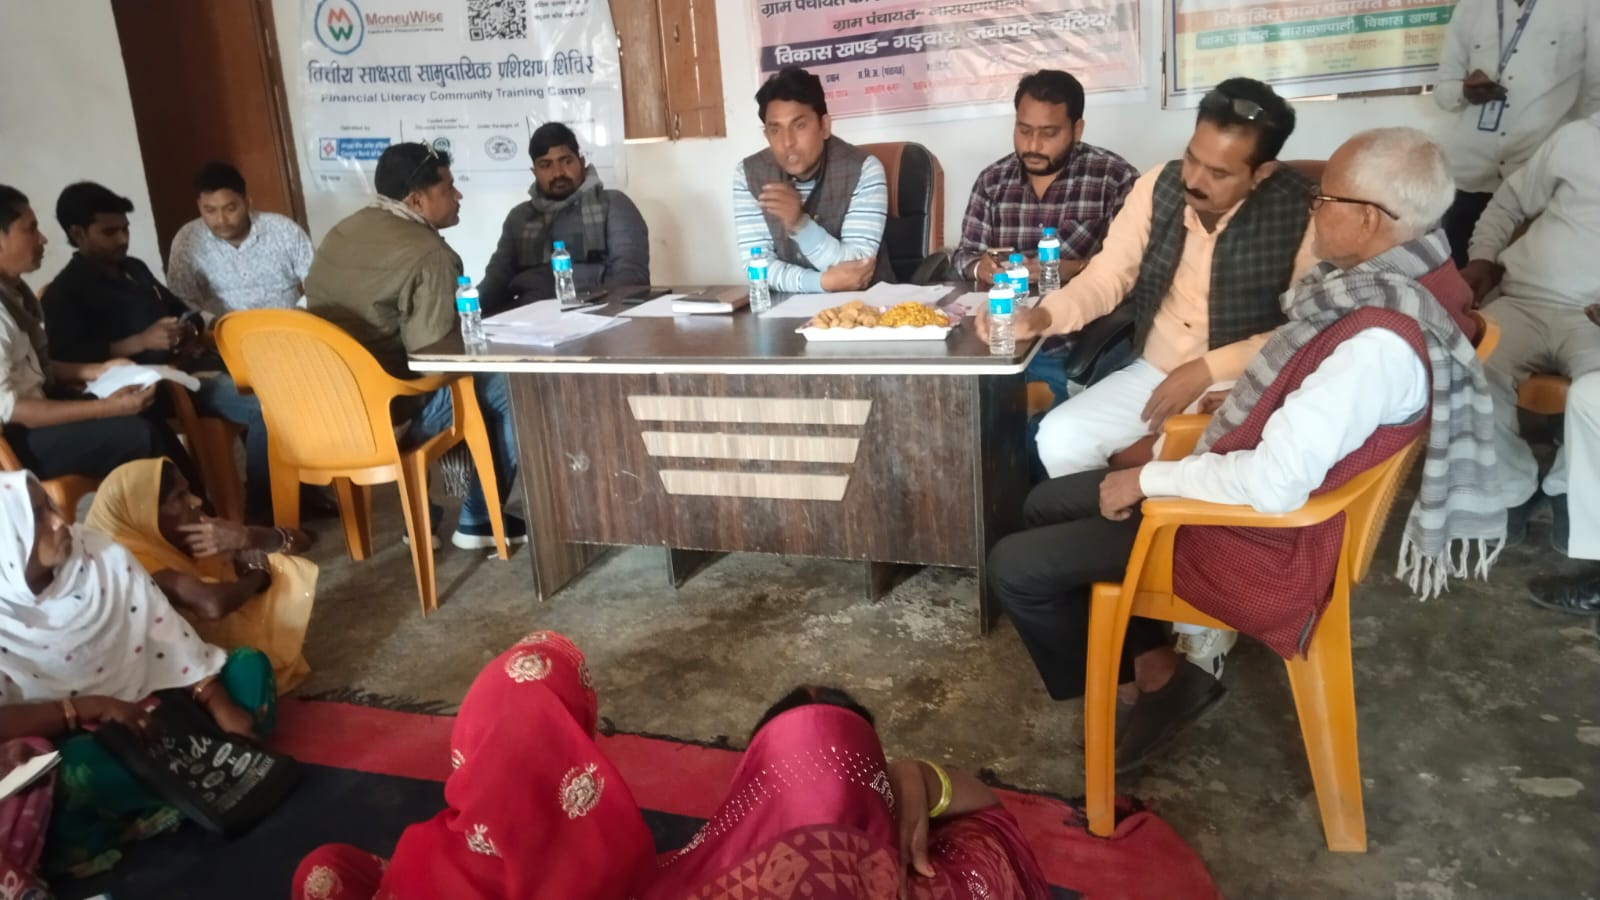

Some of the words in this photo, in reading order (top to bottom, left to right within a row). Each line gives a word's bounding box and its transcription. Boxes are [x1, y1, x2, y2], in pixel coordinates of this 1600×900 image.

[365, 11, 443, 26] MoneyWise
[775, 46, 832, 65] विकास
[357, 64, 412, 84] साक्षरता
[415, 55, 492, 88] सामुदायिक
[321, 94, 377, 103] Financial
[381, 92, 426, 103] Literacy
[430, 88, 492, 101] Community
[496, 87, 544, 99] Training
[547, 85, 586, 97] Camp
